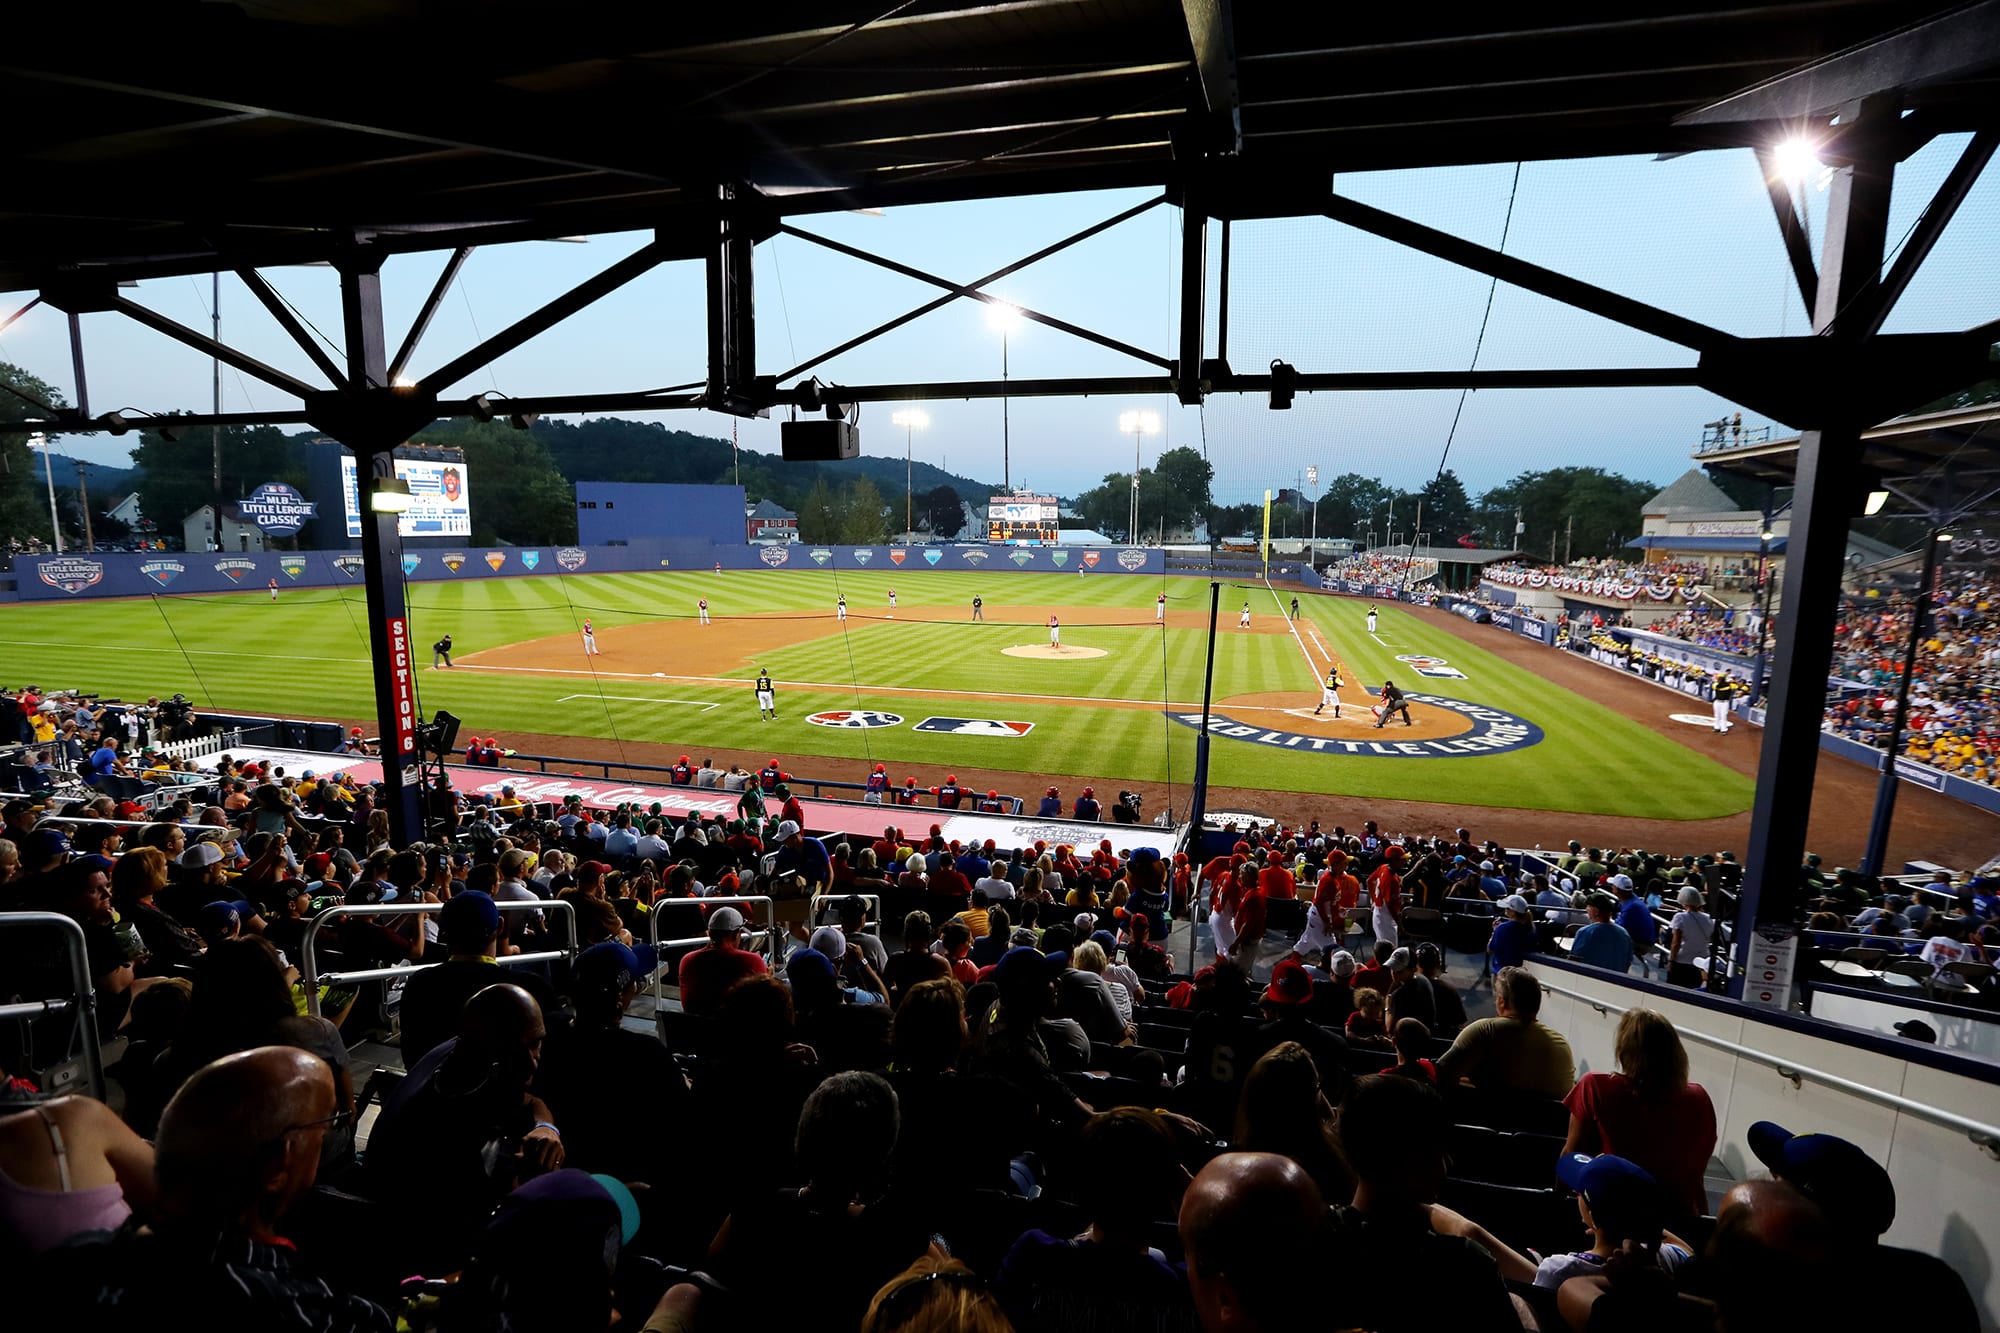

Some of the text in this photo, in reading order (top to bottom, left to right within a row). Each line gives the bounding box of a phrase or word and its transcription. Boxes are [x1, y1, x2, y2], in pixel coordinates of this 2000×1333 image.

[266, 496, 288, 504] MLB
[243, 503, 312, 515] LITTLE LEAGUE
[257, 514, 301, 526] CLASSIC
[41, 565, 100, 573] LITTLE LEAGUE
[140, 562, 185, 574] GREAT LAKES
[393, 620, 412, 731] SECTION
[760, 682, 768, 690] 15
[1179, 714, 1260, 737] MLB
[1258, 731, 1430, 755] LITTLE
[1424, 722, 1529, 754] LEAGUE
[403, 737, 414, 750] 6
[591, 786, 736, 813] Cardinals
[1014, 826, 1105, 840] LITTLE LEAGUE
[1212, 1045, 1234, 1082] 6
